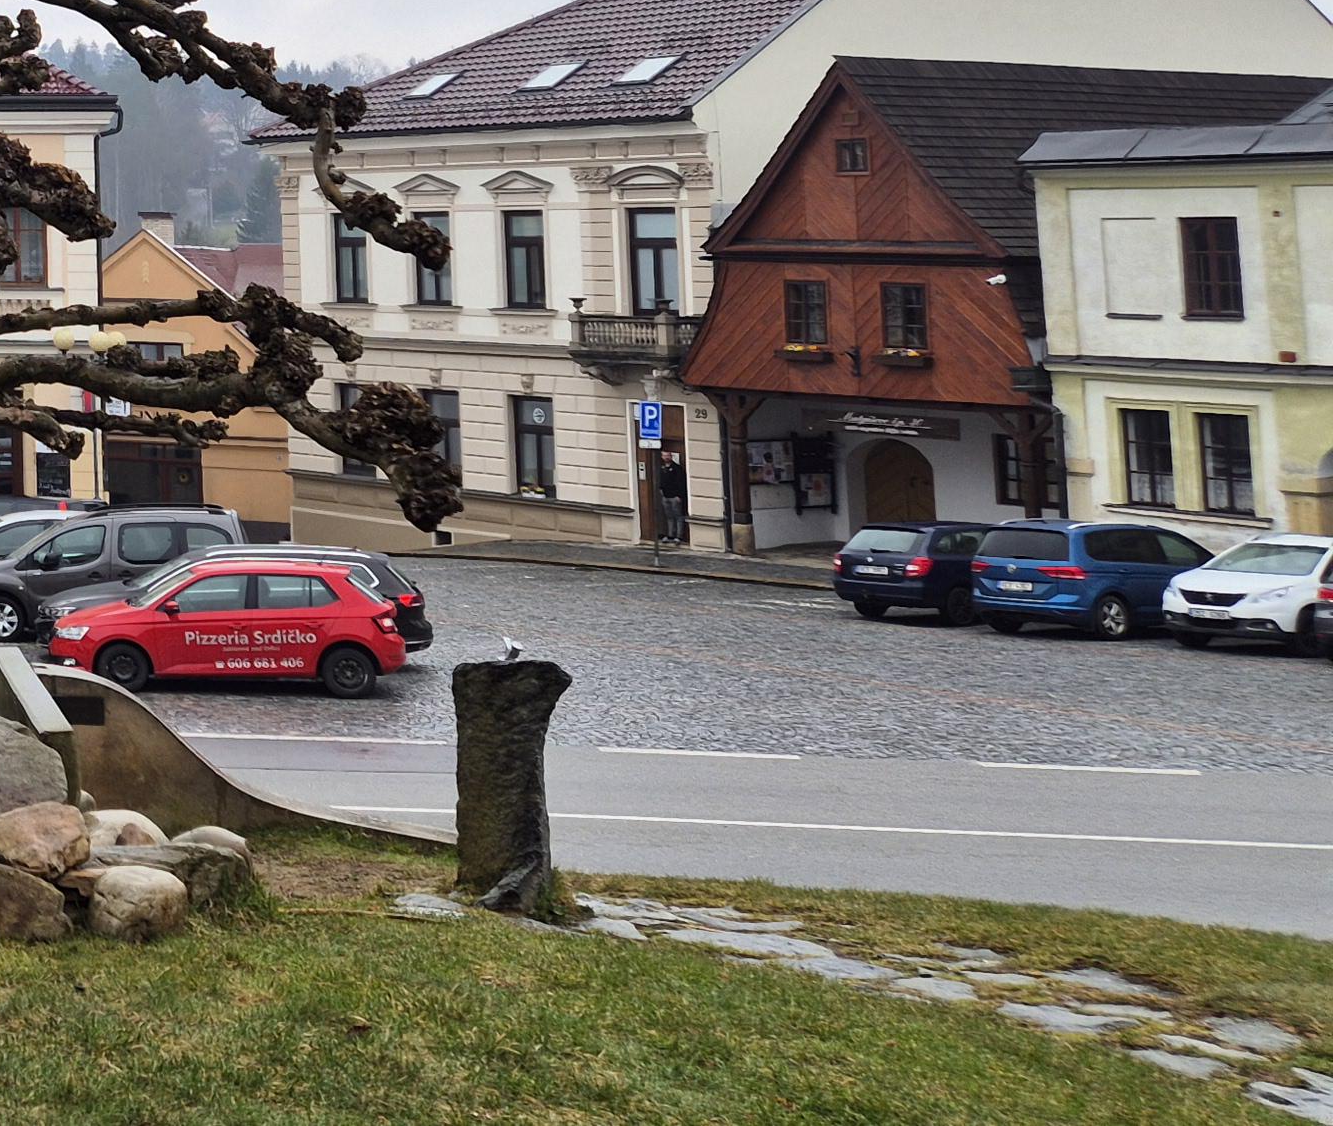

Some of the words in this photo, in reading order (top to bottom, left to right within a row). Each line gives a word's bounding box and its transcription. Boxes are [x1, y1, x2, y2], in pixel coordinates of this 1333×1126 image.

[644, 405, 658, 428] P
[694, 408, 708, 420] 29
[184, 631, 249, 645] Pizzeria
[253, 628, 317, 644] Srdíčko
[227, 657, 251, 669] 606
[279, 656, 305, 668] 406
